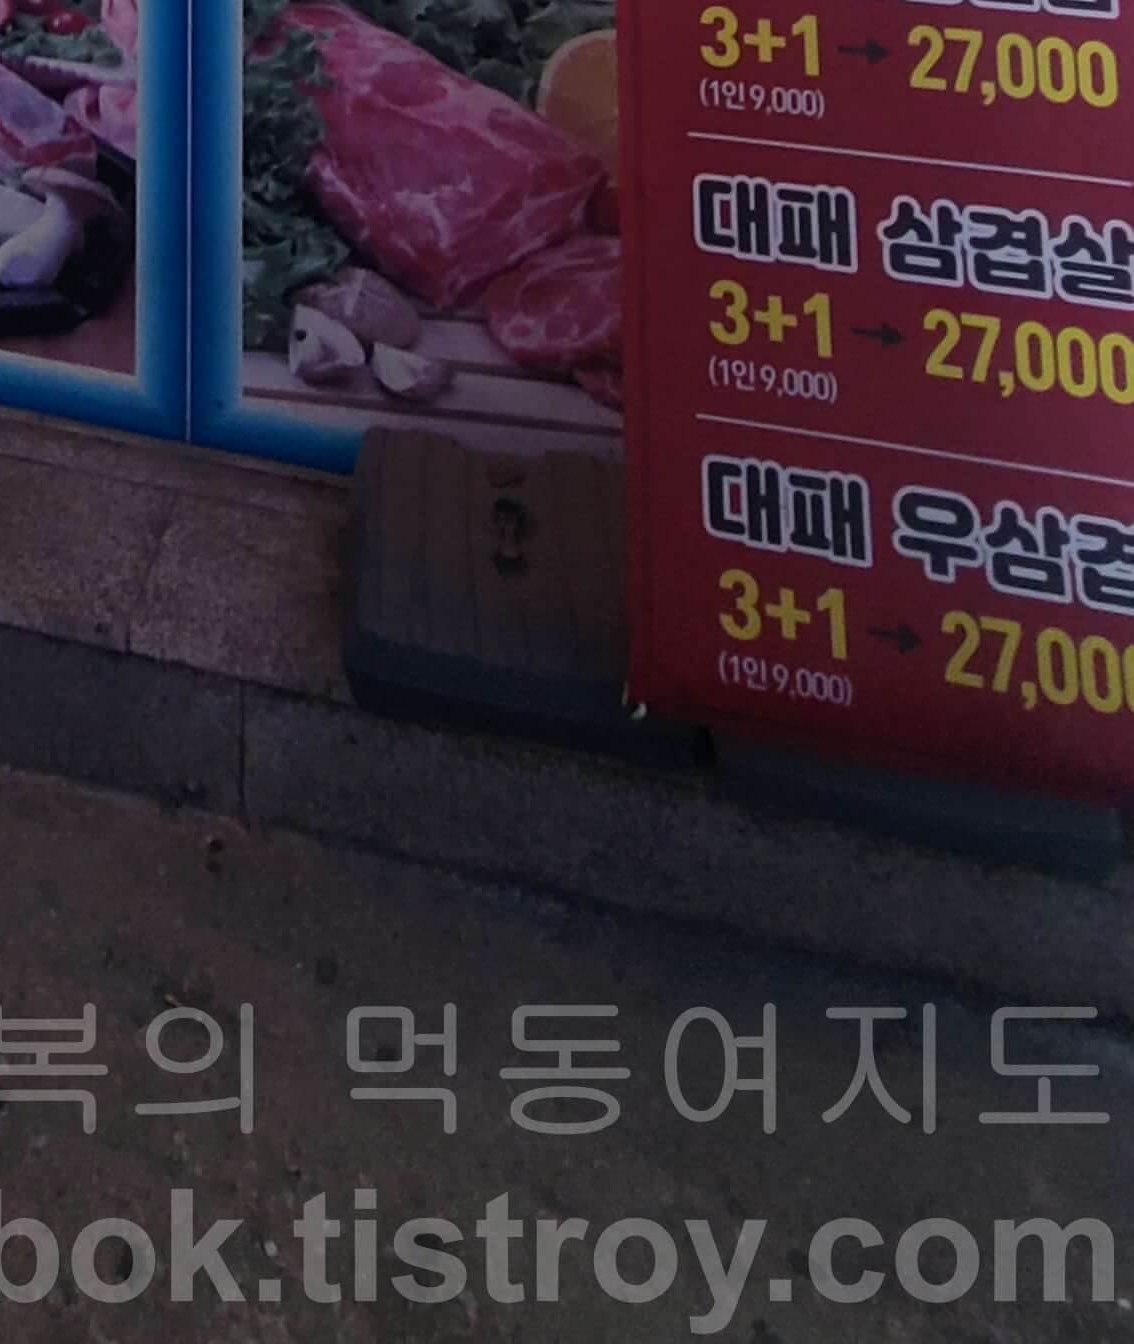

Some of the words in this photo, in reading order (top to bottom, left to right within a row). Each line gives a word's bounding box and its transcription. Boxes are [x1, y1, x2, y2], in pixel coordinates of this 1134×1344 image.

[699, 5, 821, 77] 3+1
[907, 25, 1118, 108] 27,000
[693, 174, 859, 274] 대패
[877, 195, 1134, 310] 삼겹살
[708, 279, 833, 358] 3+1
[923, 308, 1134, 405] 27,000
[701, 454, 874, 568] 대패
[719, 569, 847, 659] 3+1
[941, 610, 1134, 714] 27,00
